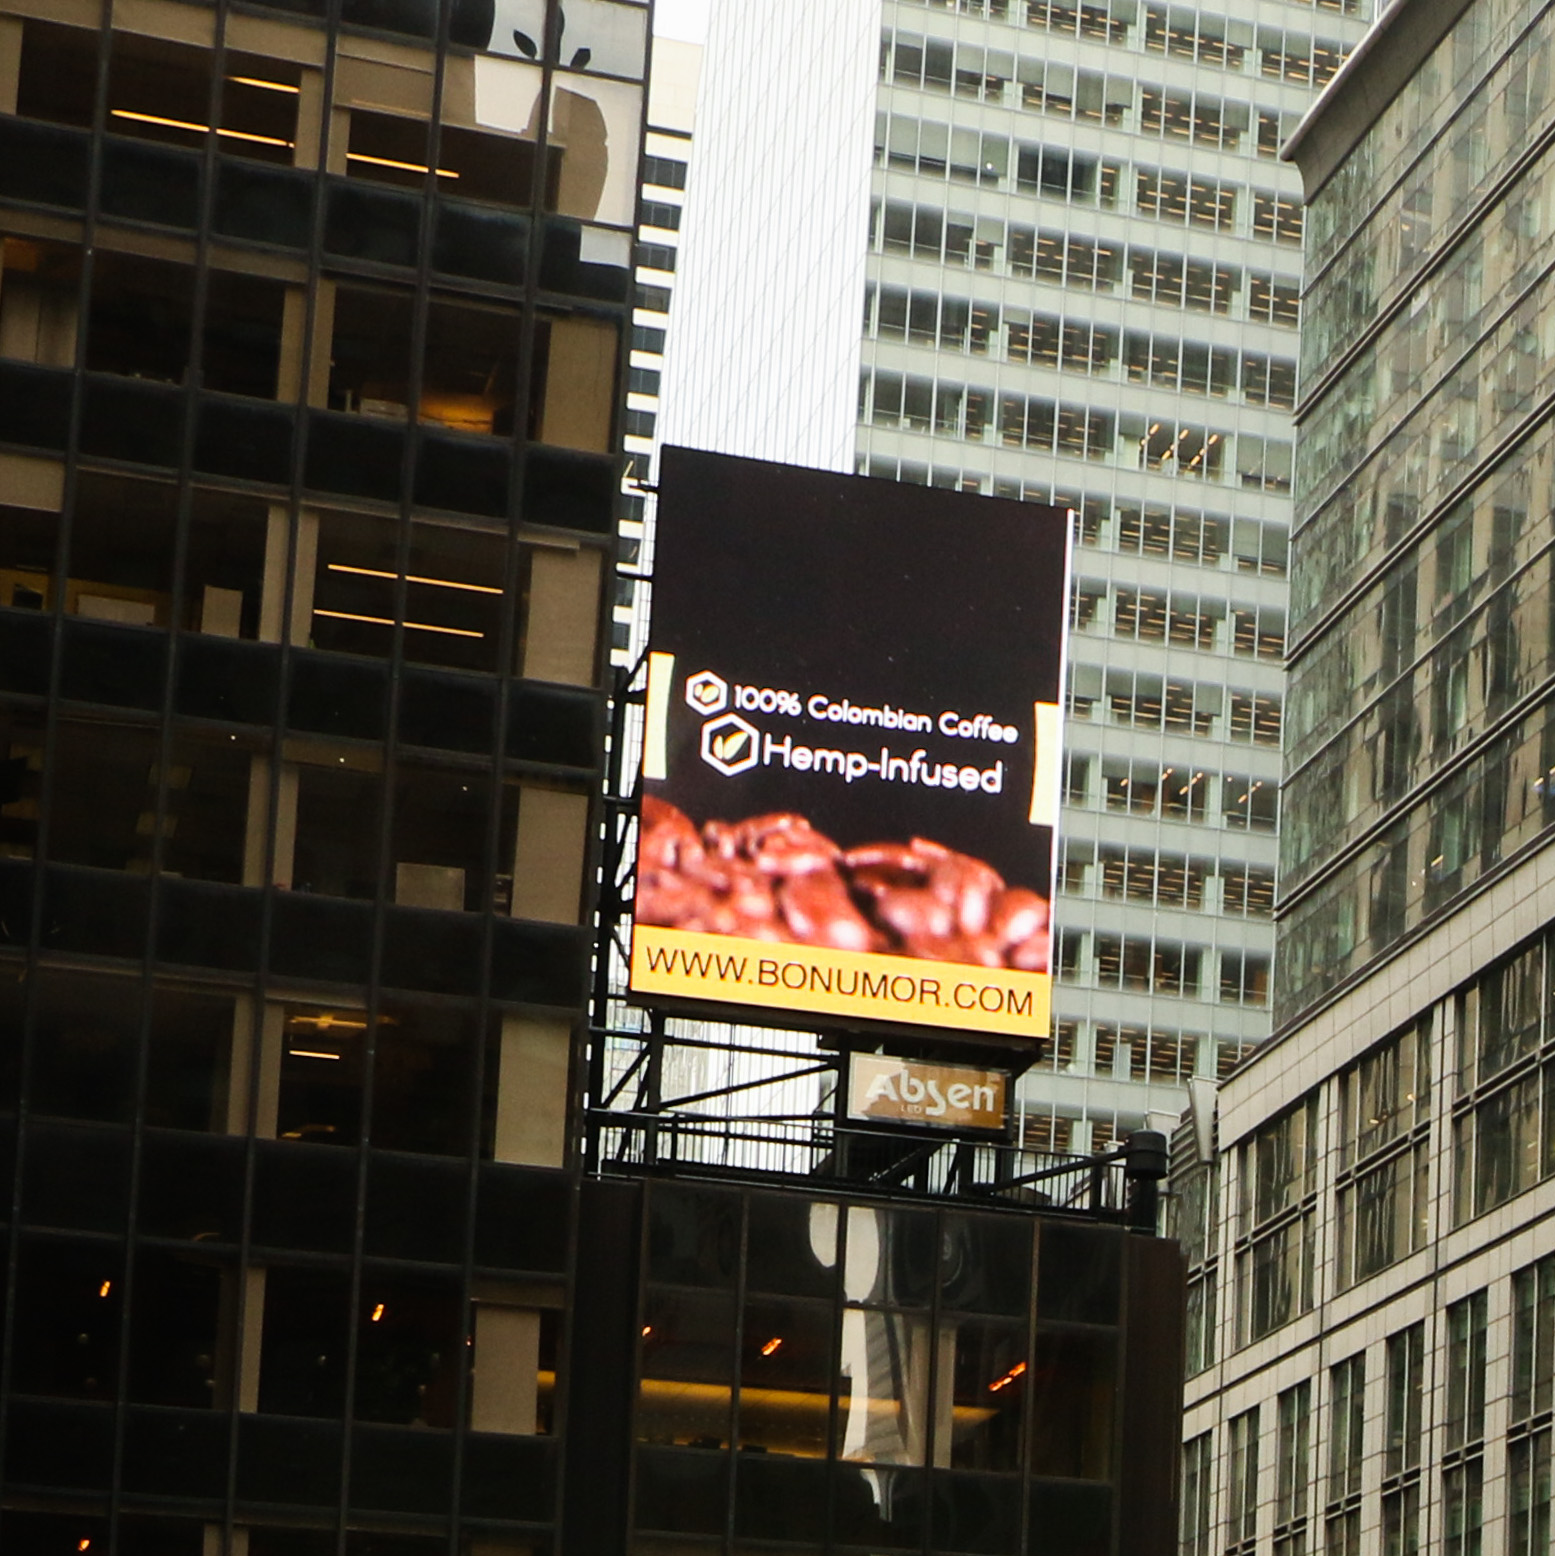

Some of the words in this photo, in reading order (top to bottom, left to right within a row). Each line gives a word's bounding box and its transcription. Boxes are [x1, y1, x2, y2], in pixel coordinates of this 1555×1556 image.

[734, 684, 801, 716] 100%
[808, 694, 932, 733] Colombian
[938, 711, 1019, 744] Coffee
[763, 732, 1004, 794] Hemp-Infused
[647, 945, 1033, 1017] WWW.BONUMOR.COM
[866, 1069, 995, 1116] Absen
